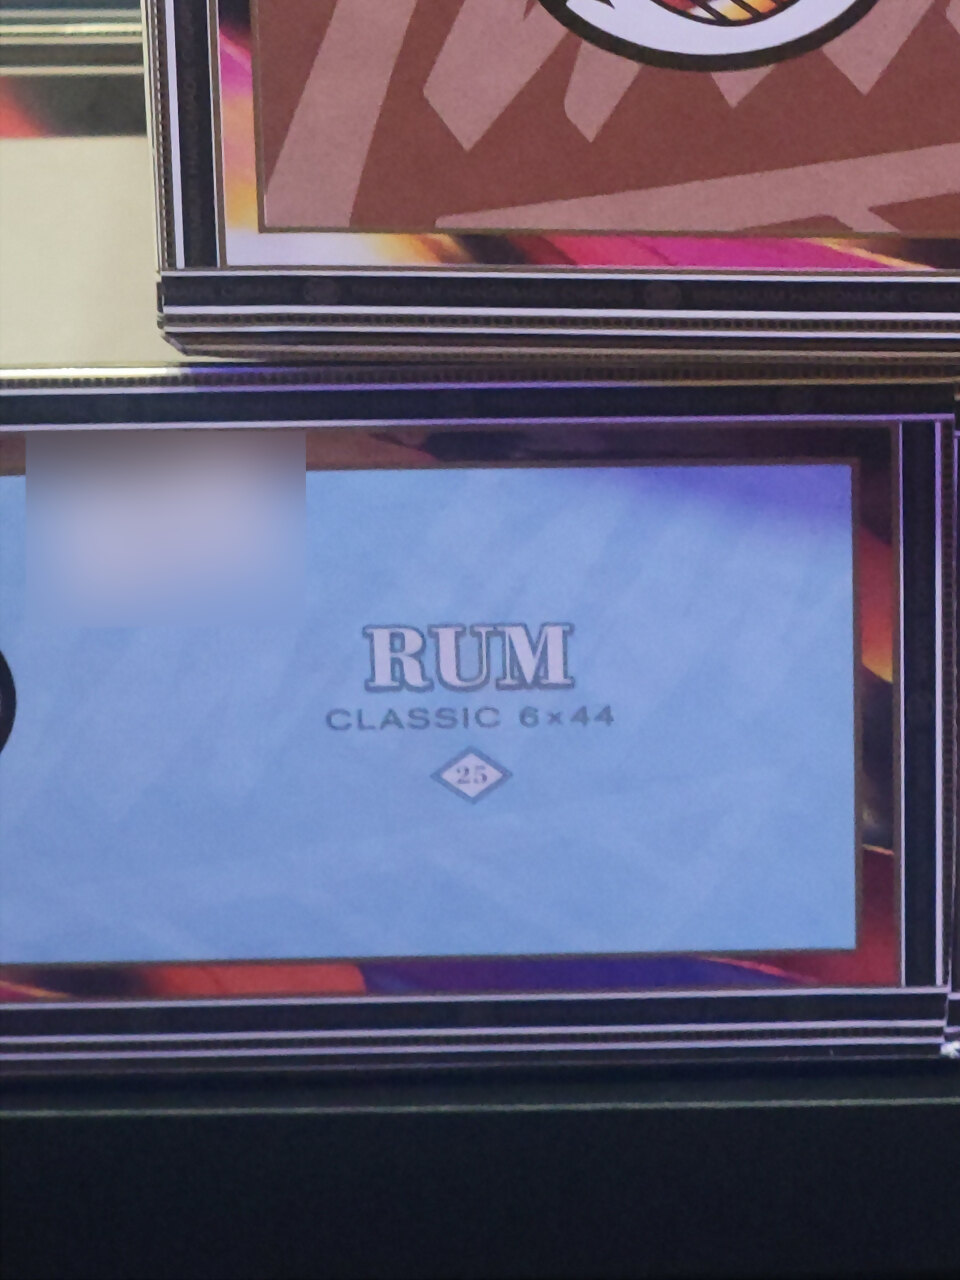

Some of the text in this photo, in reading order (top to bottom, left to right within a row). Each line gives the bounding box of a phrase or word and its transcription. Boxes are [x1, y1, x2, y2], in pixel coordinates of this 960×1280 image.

[362, 622, 574, 692] RUM
[326, 706, 501, 731] CLASSIC
[456, 765, 489, 785] 25
